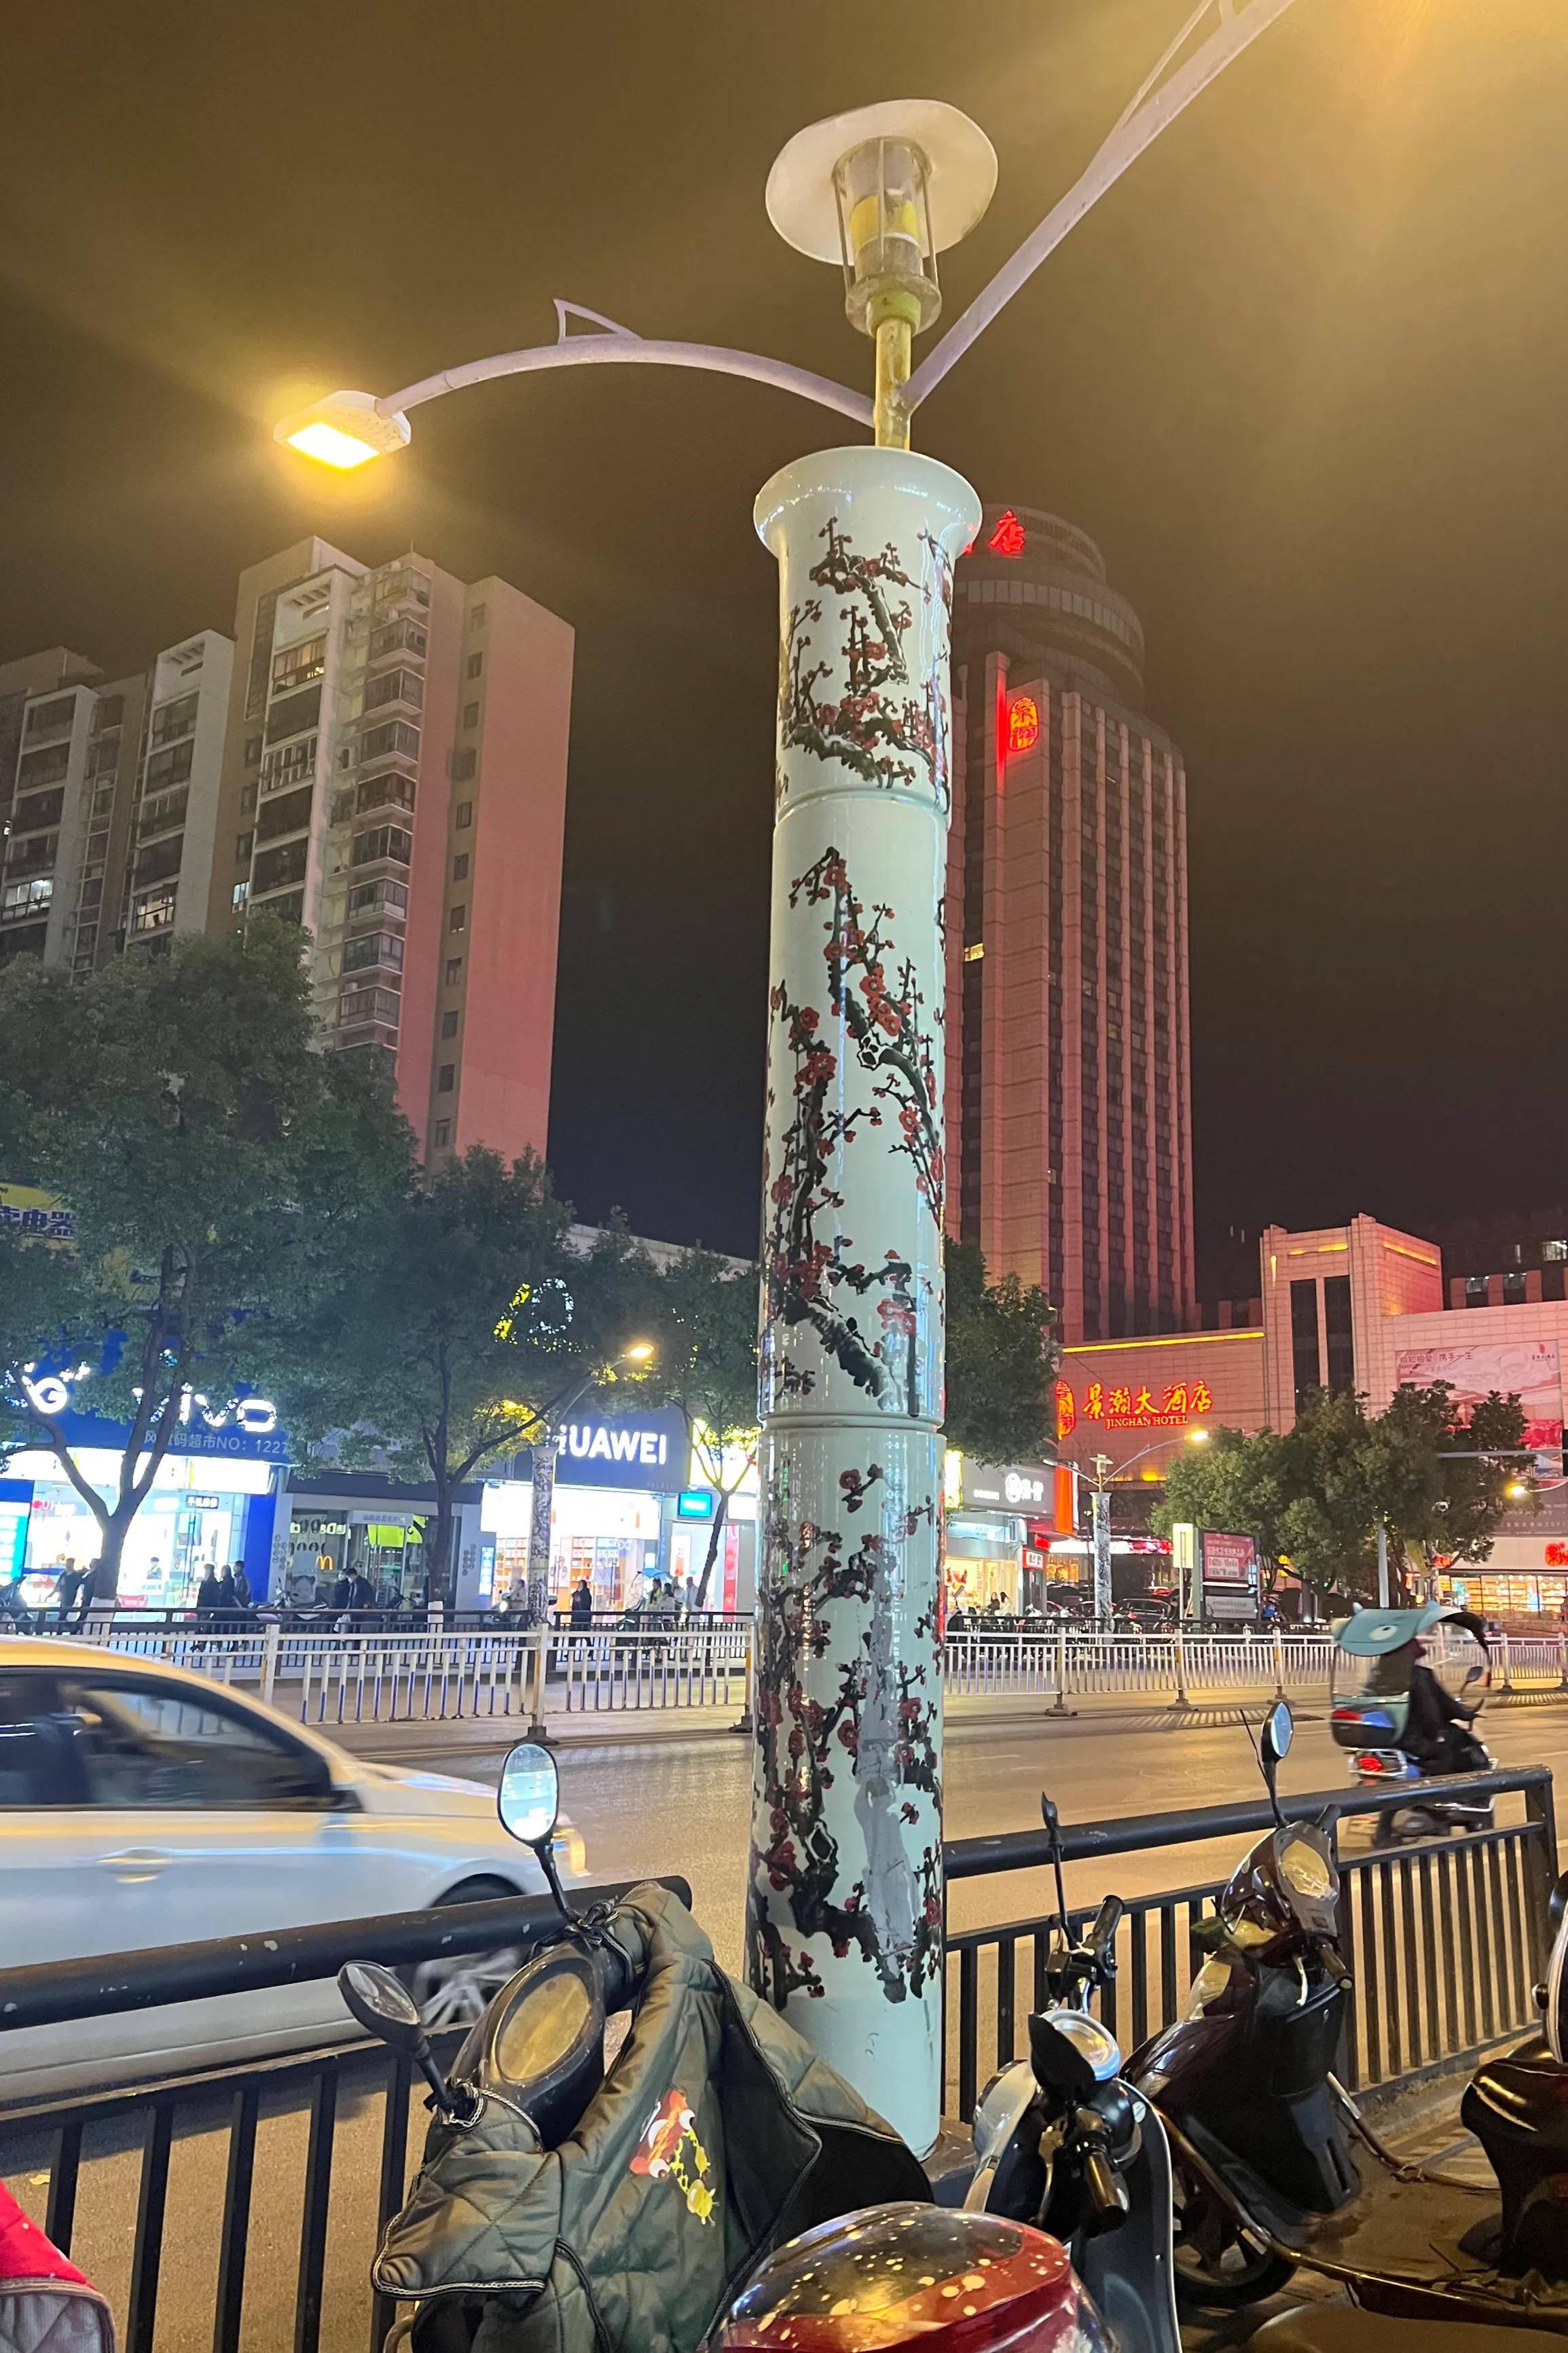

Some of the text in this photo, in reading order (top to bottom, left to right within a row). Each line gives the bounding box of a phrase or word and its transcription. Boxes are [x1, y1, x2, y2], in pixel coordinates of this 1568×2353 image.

[989, 510, 1025, 553] 店
[1106, 1415, 1188, 1430] JINGHAN HOTEL
